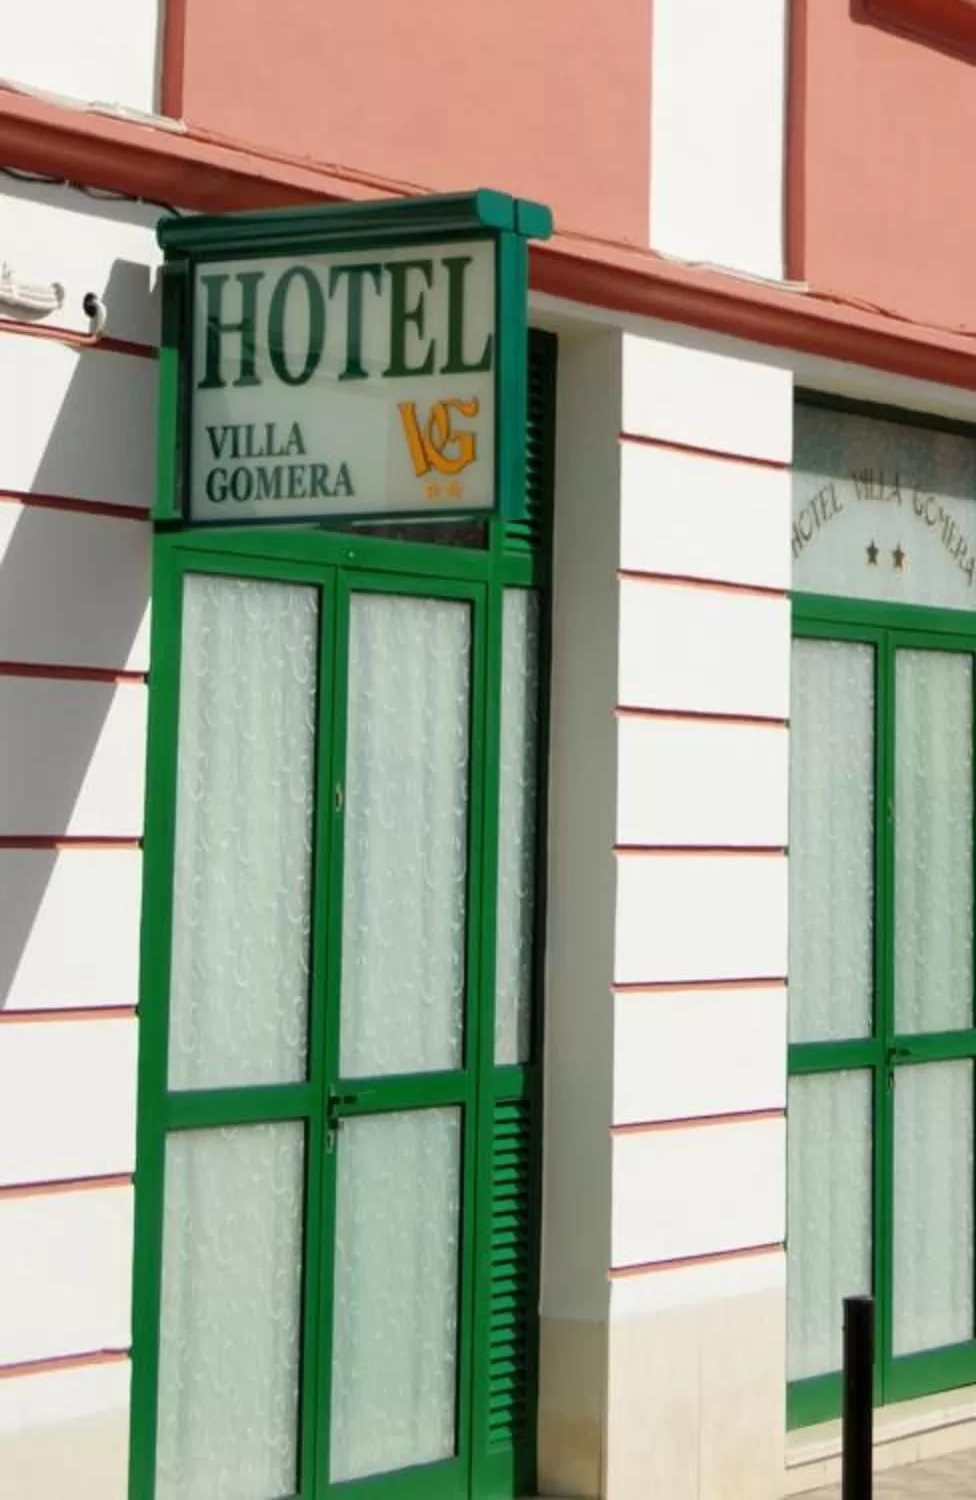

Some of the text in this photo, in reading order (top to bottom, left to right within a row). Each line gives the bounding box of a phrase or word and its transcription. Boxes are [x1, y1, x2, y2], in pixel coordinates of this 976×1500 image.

[198, 256, 493, 388] HOTEL
[206, 421, 307, 460] VILLA
[205, 462, 355, 503] GOMERA
[791, 467, 976, 587] HOTEL VILLA GOMERA
